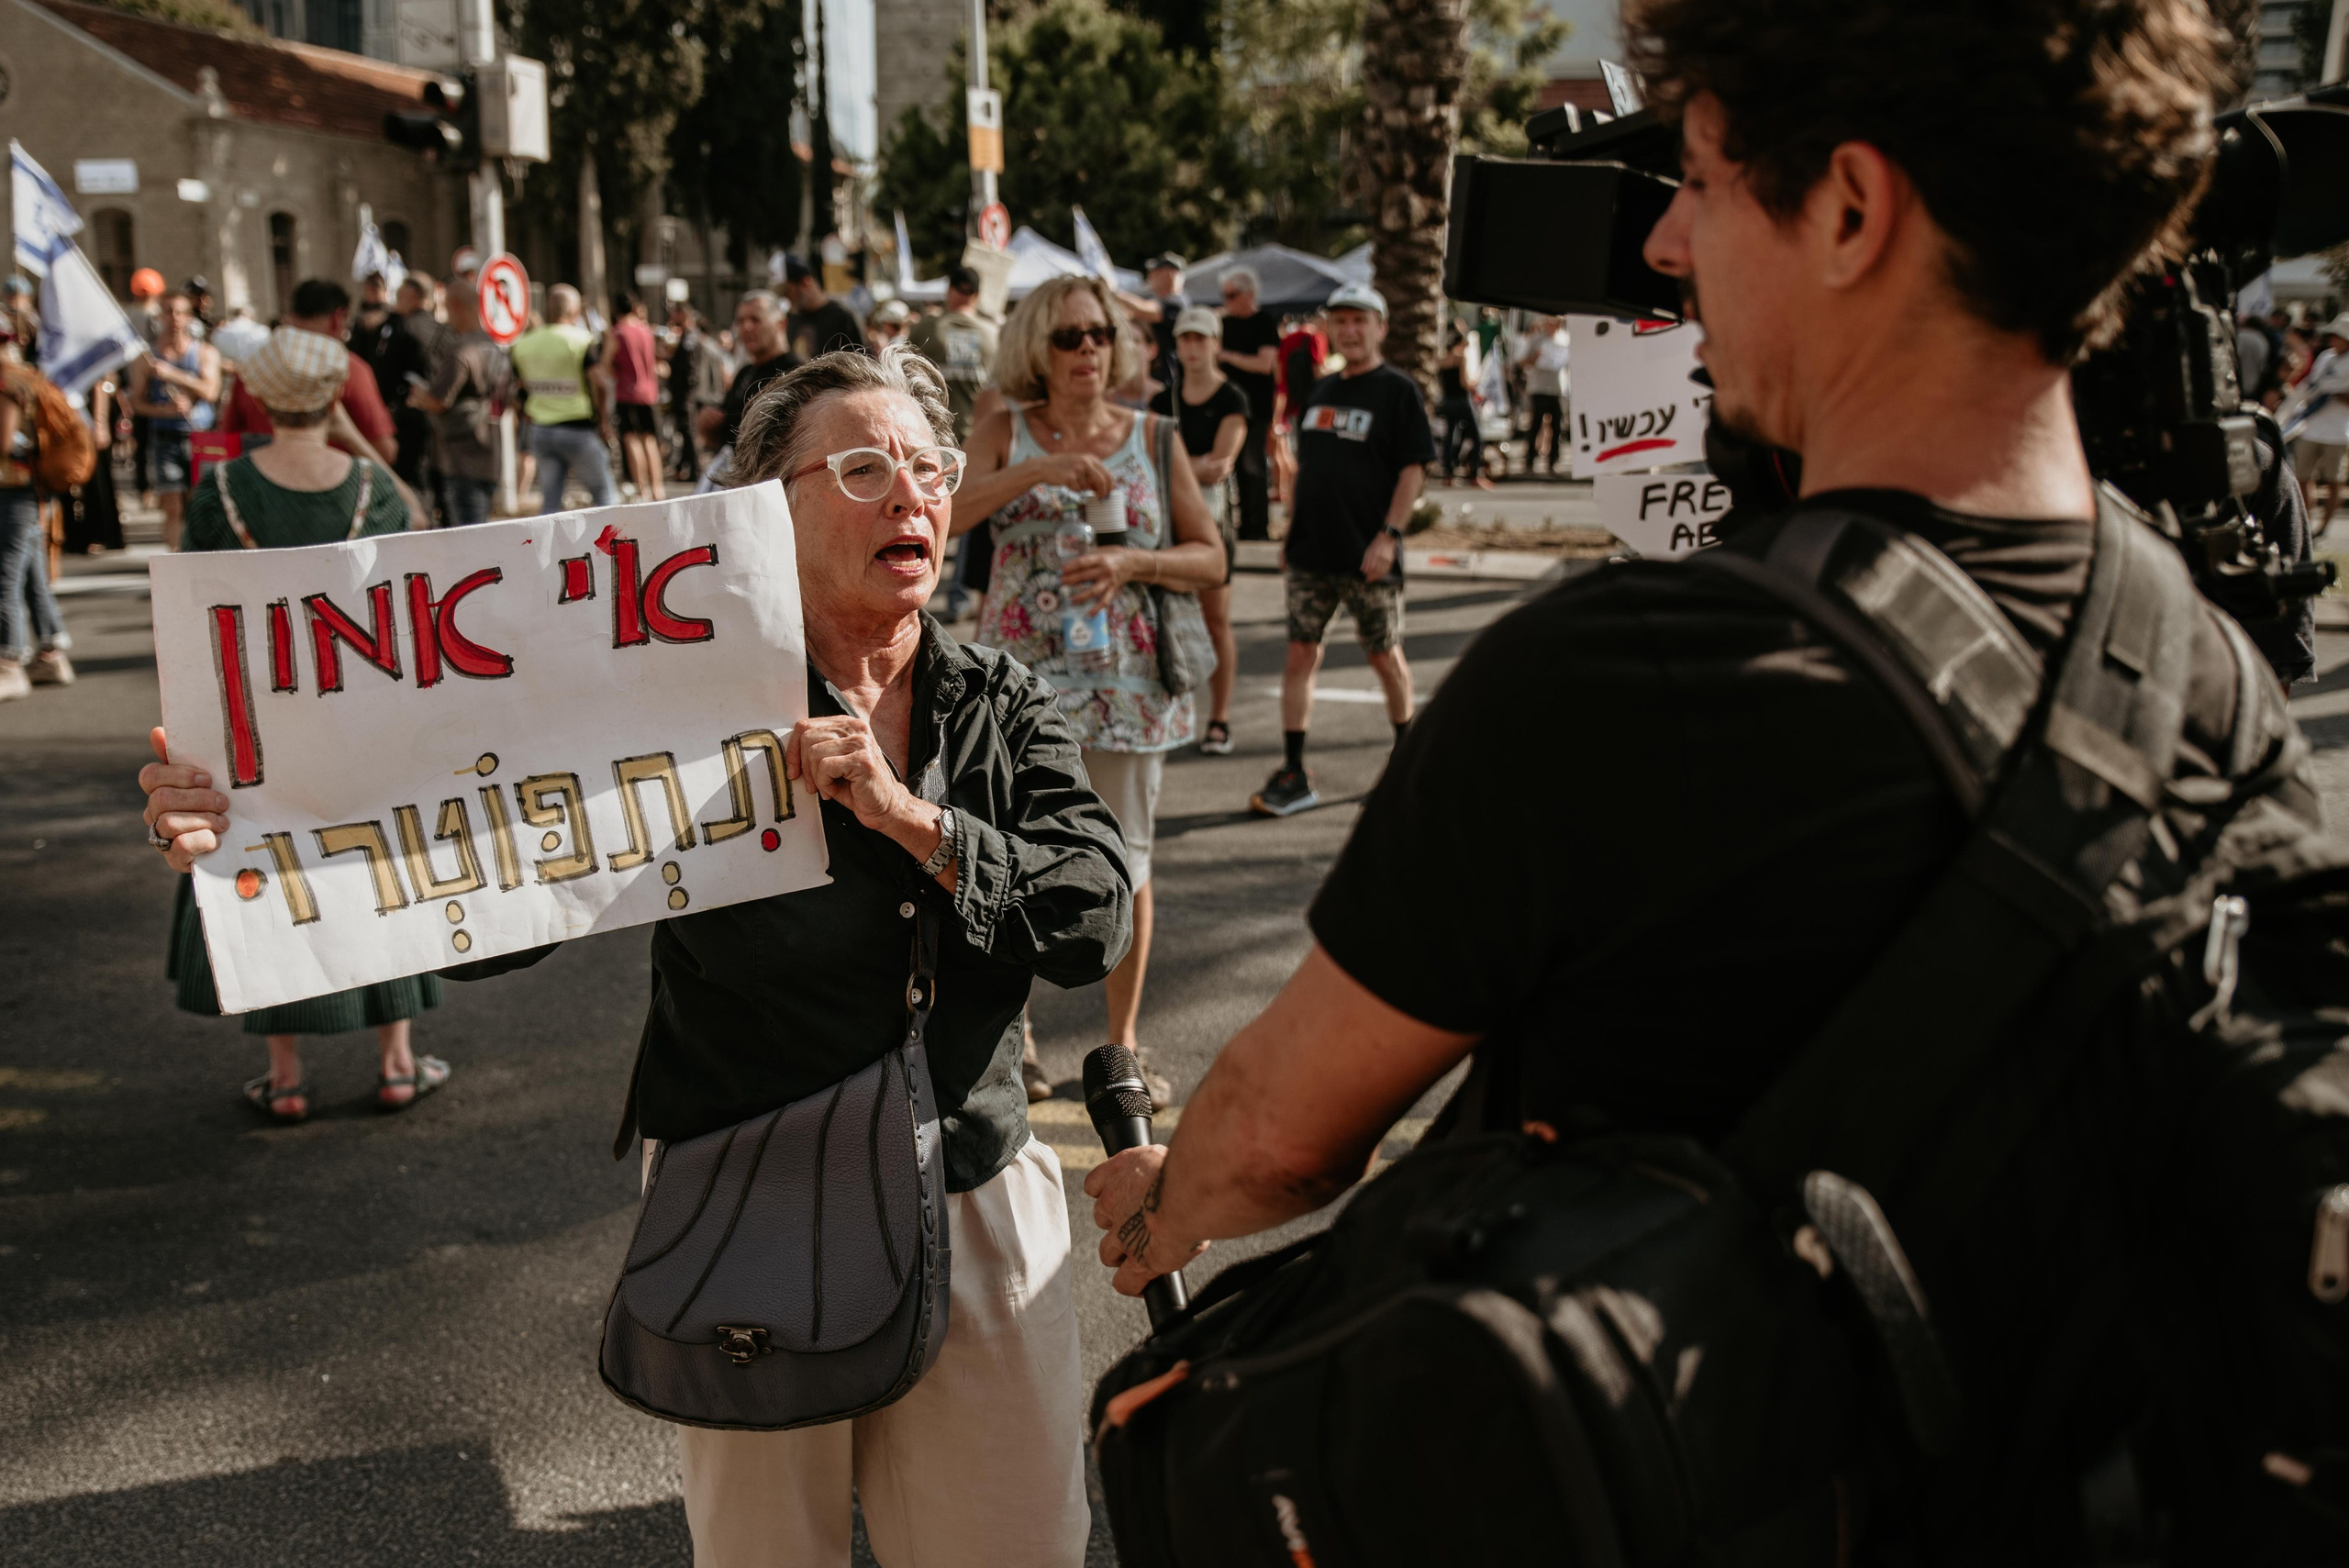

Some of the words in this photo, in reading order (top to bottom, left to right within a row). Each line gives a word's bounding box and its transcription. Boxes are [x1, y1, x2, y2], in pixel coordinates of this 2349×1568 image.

[1639, 480, 1726, 520] FRE
[558, 537, 719, 650] אי
[207, 566, 515, 790] אמון
